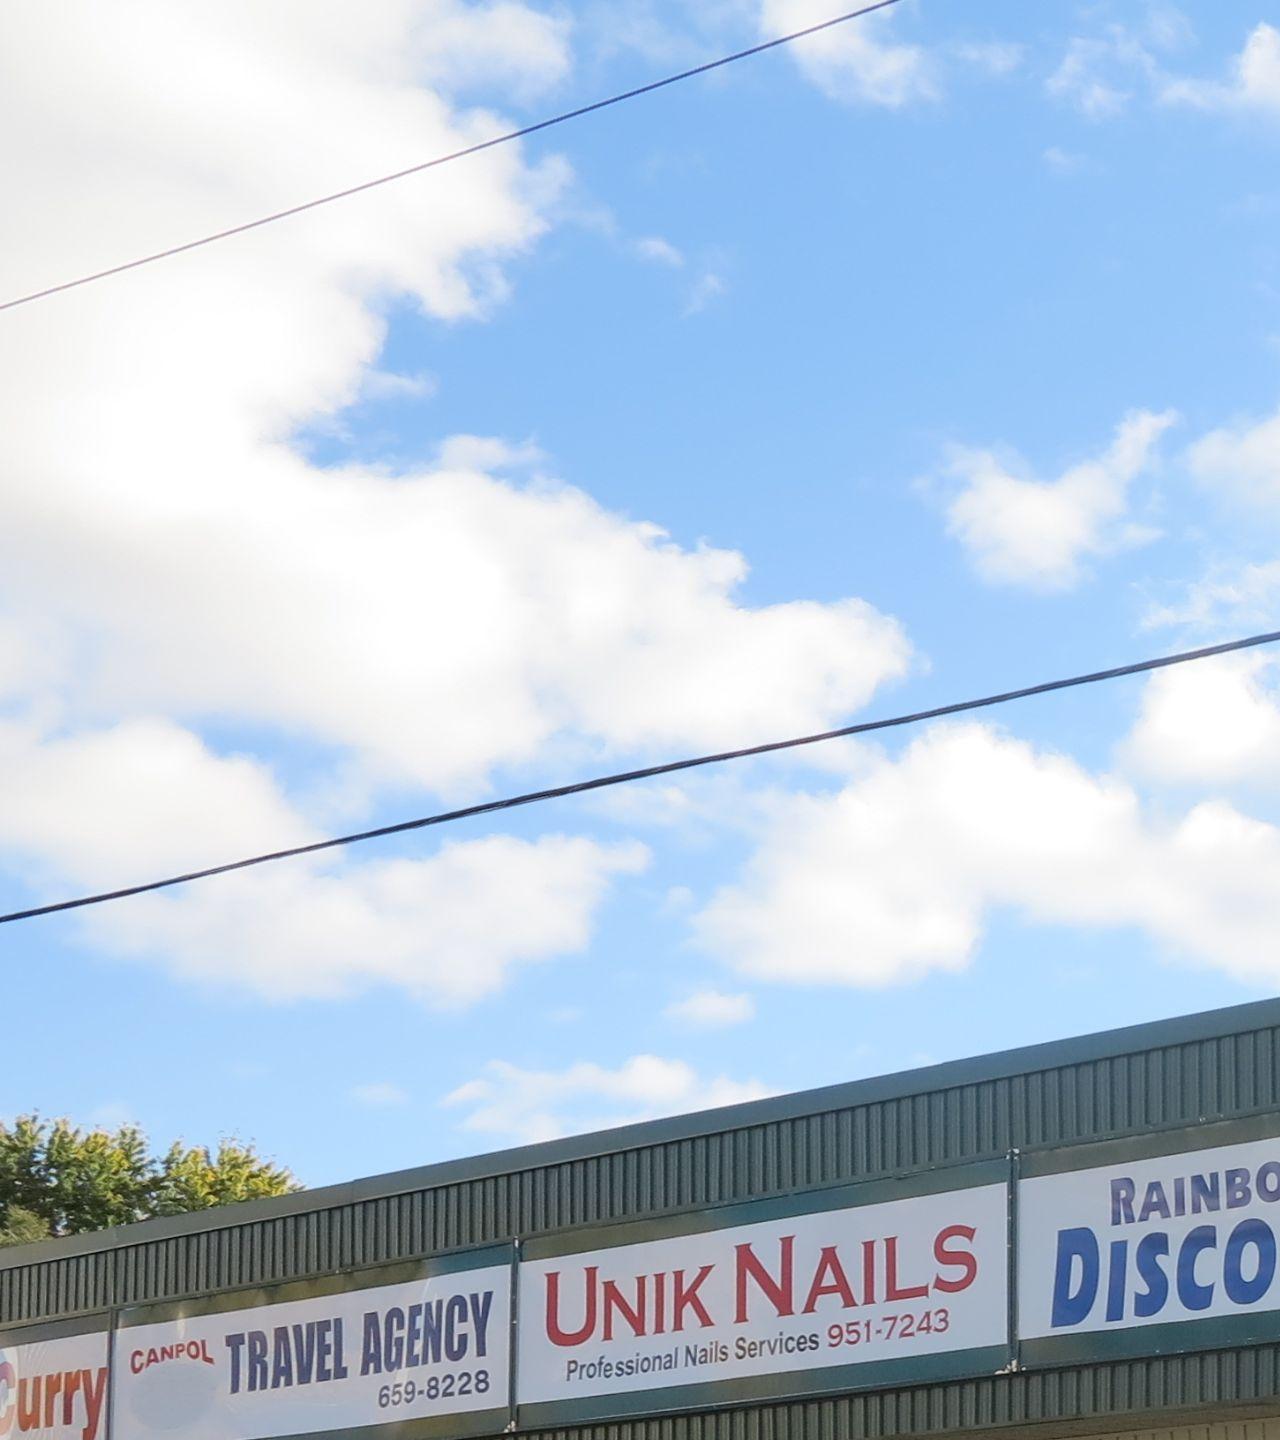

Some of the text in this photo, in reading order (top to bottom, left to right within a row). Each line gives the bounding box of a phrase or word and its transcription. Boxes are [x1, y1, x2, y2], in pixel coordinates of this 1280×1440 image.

[544, 1224, 978, 1347] UNIK NAILS
[130, 1337, 215, 1375] CANPOL
[225, 1290, 493, 1395] TRAVEL AGENCY
[566, 1309, 950, 1382] Professional Nails Services 951-7243
[377, 1370, 490, 1409] 659-8228
